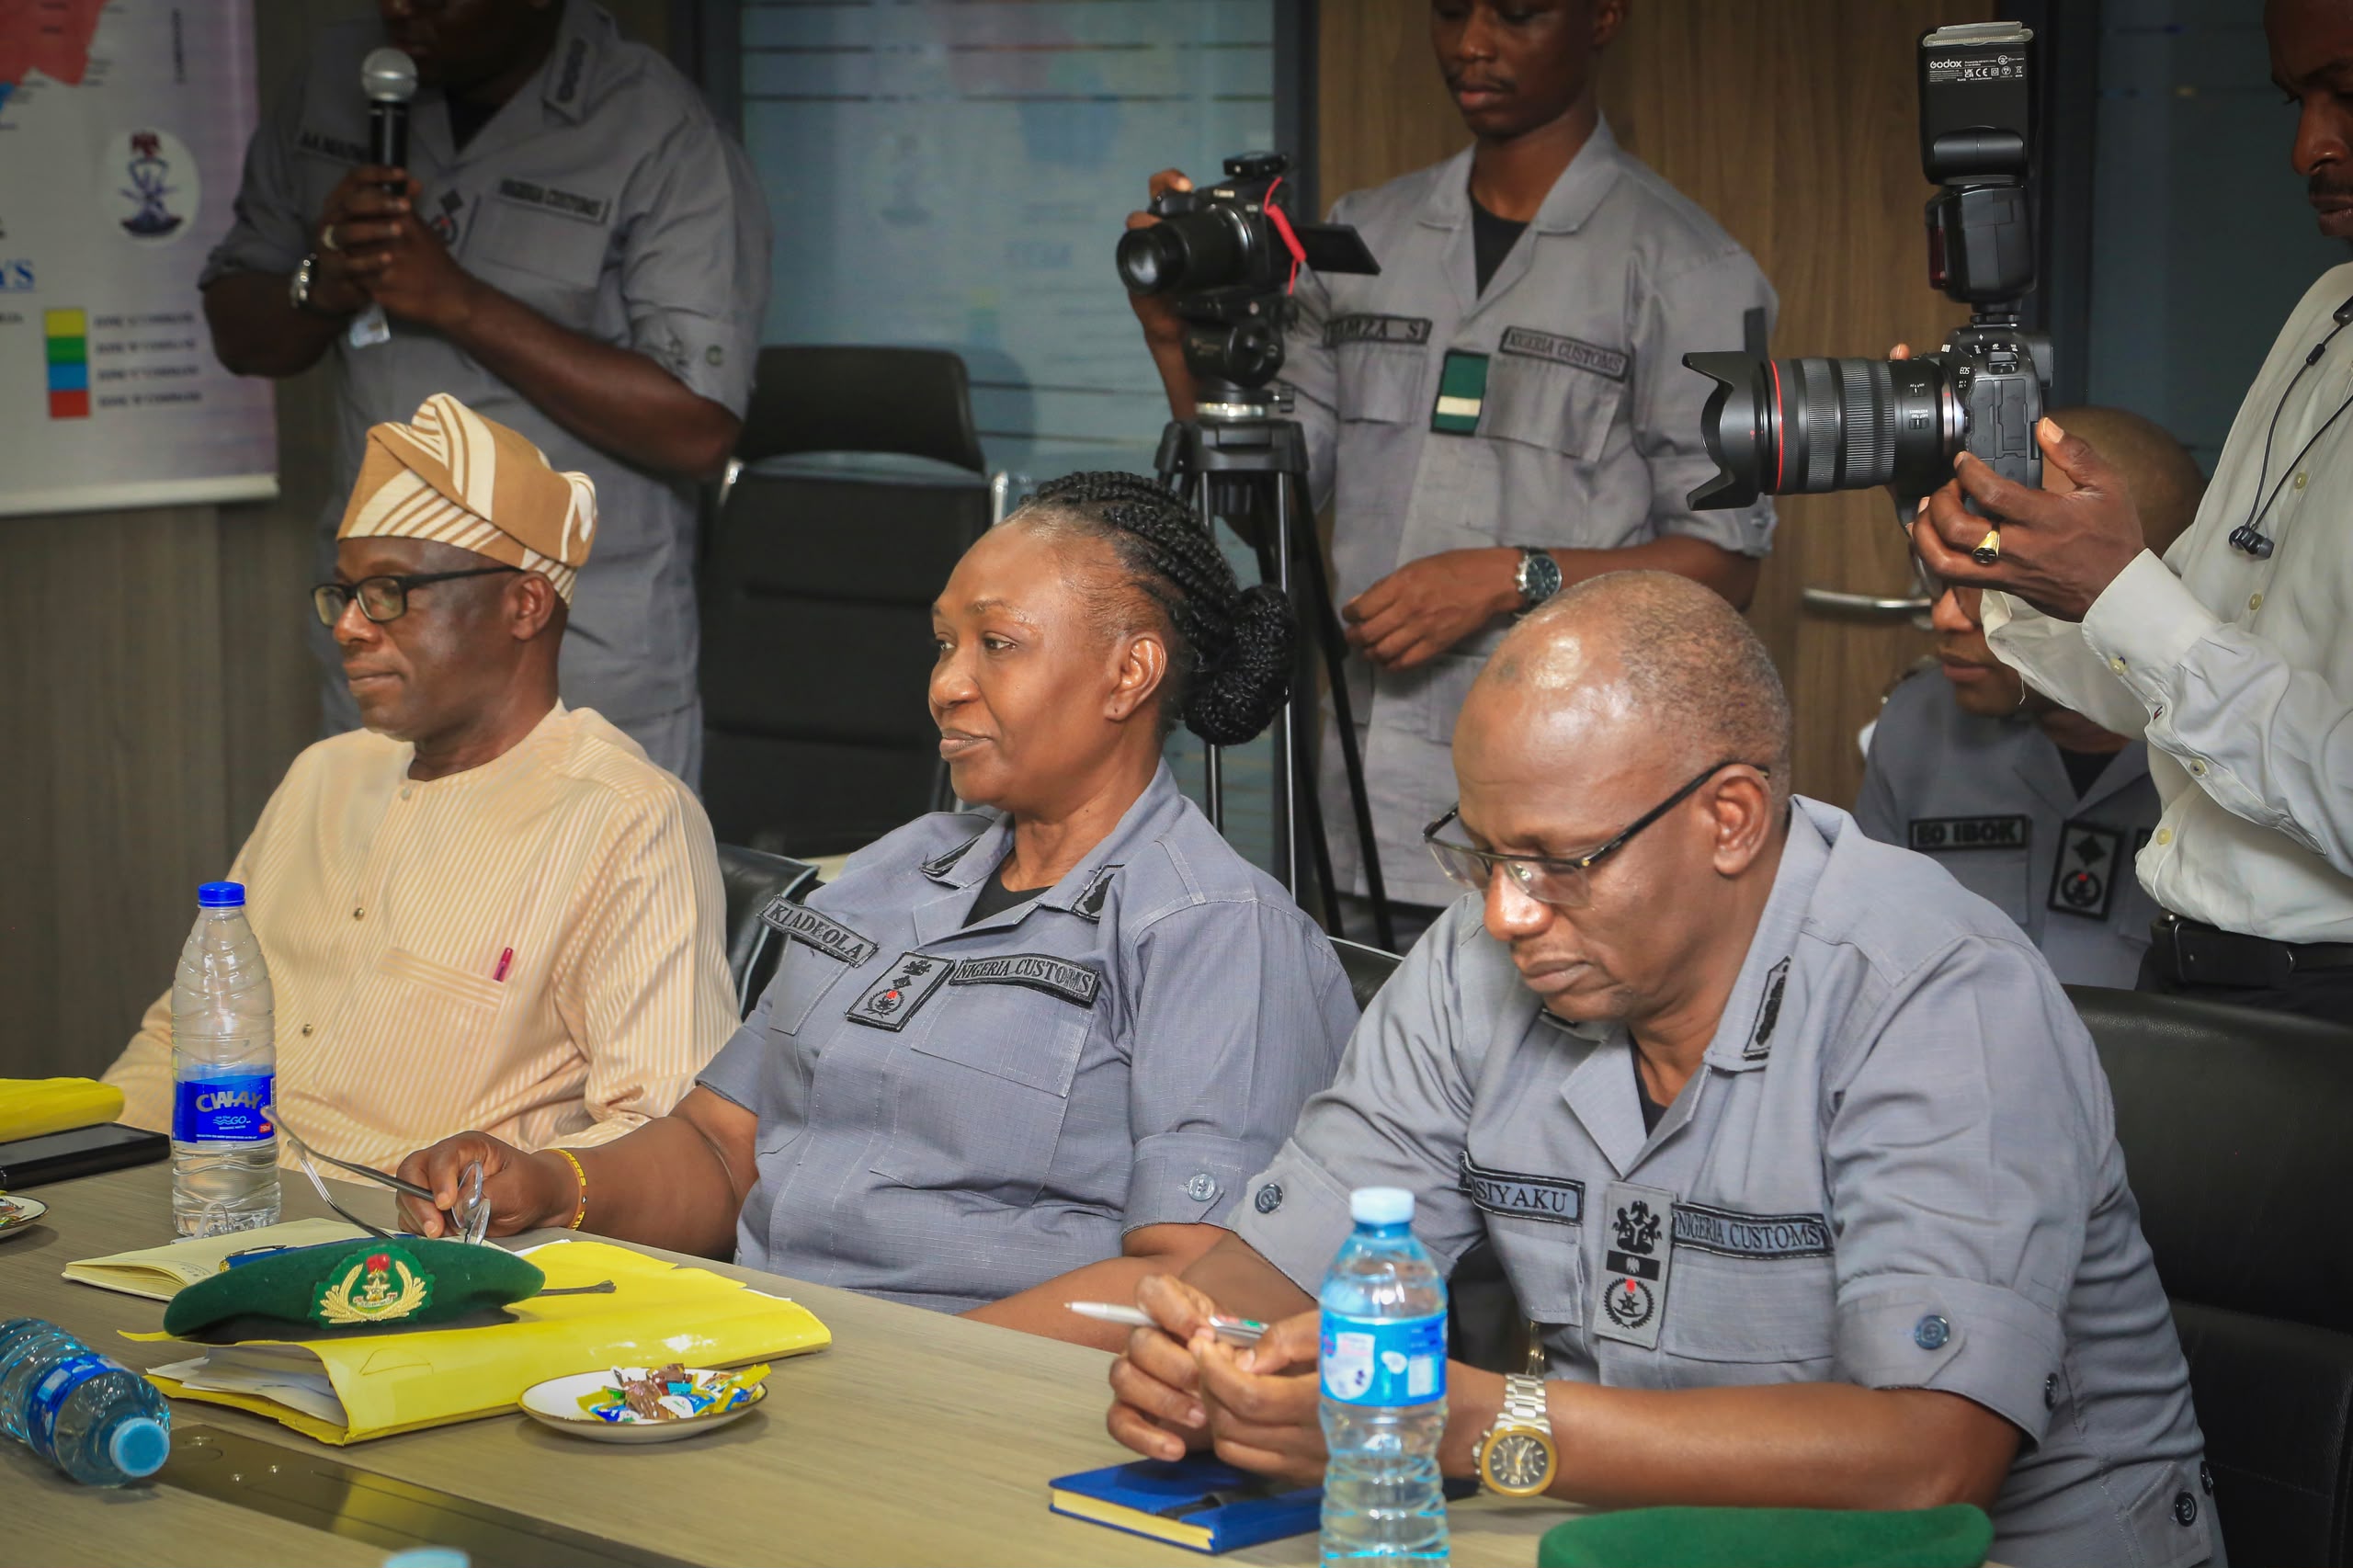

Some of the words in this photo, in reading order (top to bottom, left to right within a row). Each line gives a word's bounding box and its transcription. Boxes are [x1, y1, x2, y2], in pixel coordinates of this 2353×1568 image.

[1930, 59, 1962, 69] Godox
[1510, 332, 1554, 354] NIGERIA
[1558, 341, 1623, 371] CUSTOMS
[1953, 820, 2016, 843] IBOK
[957, 958, 1011, 980] NIGERIA
[1015, 958, 1093, 994] CUSTOMS
[196, 1090, 263, 1112] CWAY
[1677, 1211, 1725, 1245] NIGERIA
[1729, 1222, 1823, 1250] CUSTOMS
